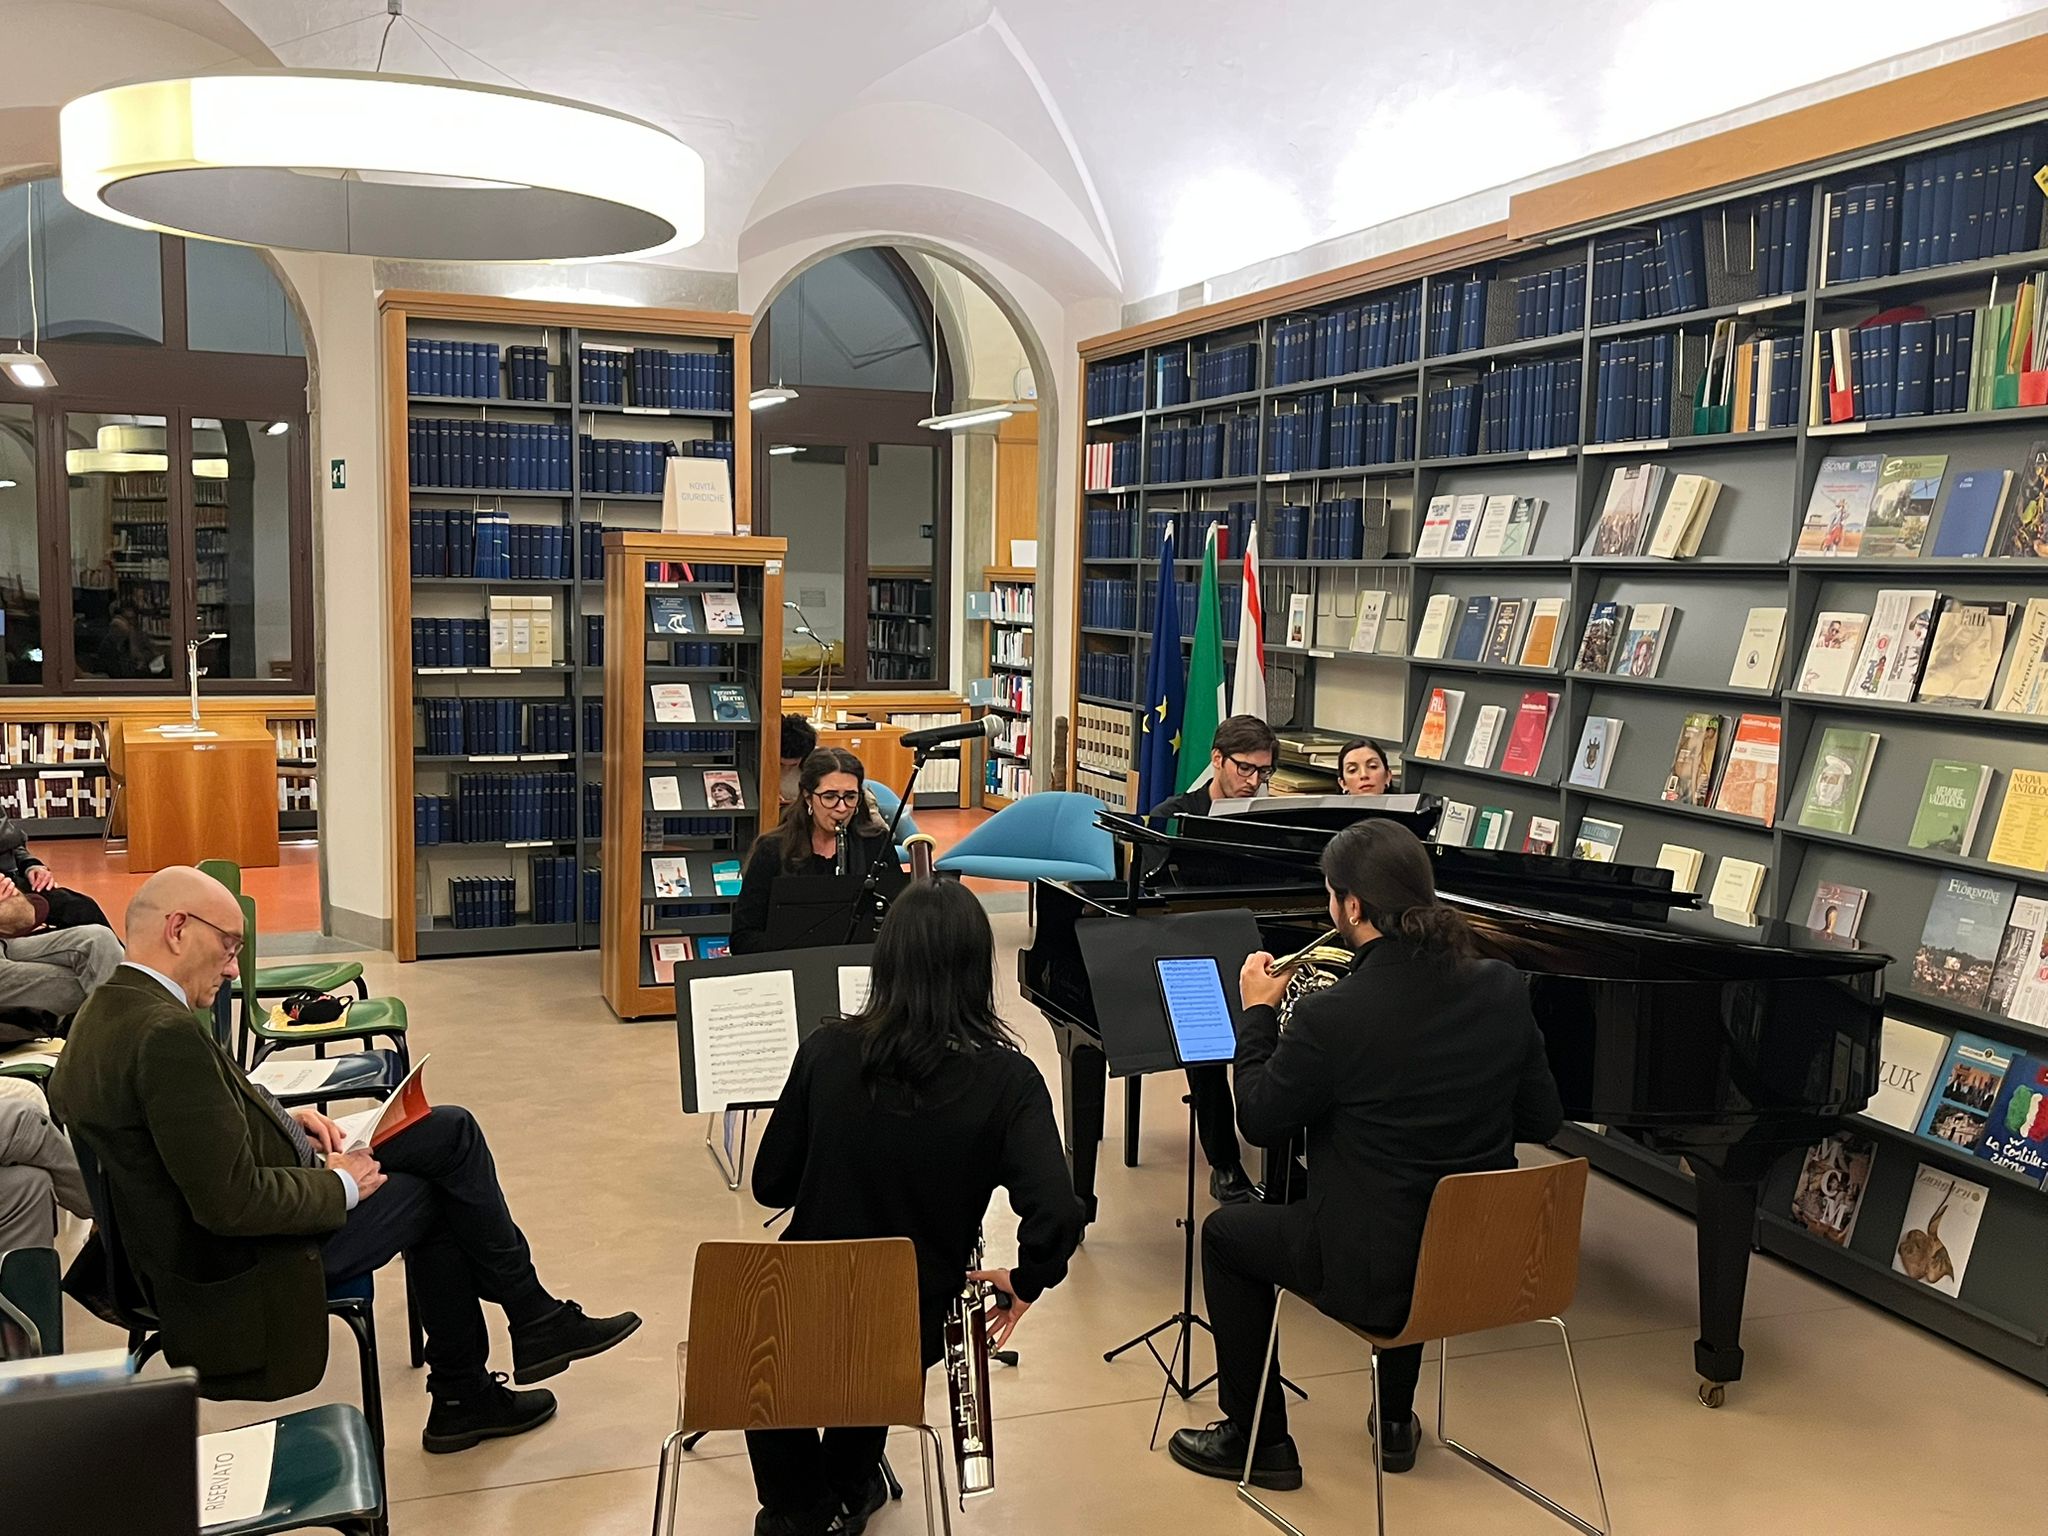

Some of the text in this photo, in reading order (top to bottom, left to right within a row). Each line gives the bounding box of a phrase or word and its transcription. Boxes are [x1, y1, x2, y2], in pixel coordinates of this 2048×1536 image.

[689, 482, 716, 491] NOVITÀ
[681, 492, 725, 503] GIURIDICHE
[969, 594, 976, 609] 1
[971, 682, 978, 697] 1
[2006, 658, 2034, 711] Florence
[2014, 773, 2042, 786] NUOVA
[1936, 785, 1965, 798] MEMORIE
[1929, 793, 1967, 809] VALDARNESI
[1948, 878, 2000, 904] FLORENTINE
[204, 1452, 235, 1512] RISERVATO
